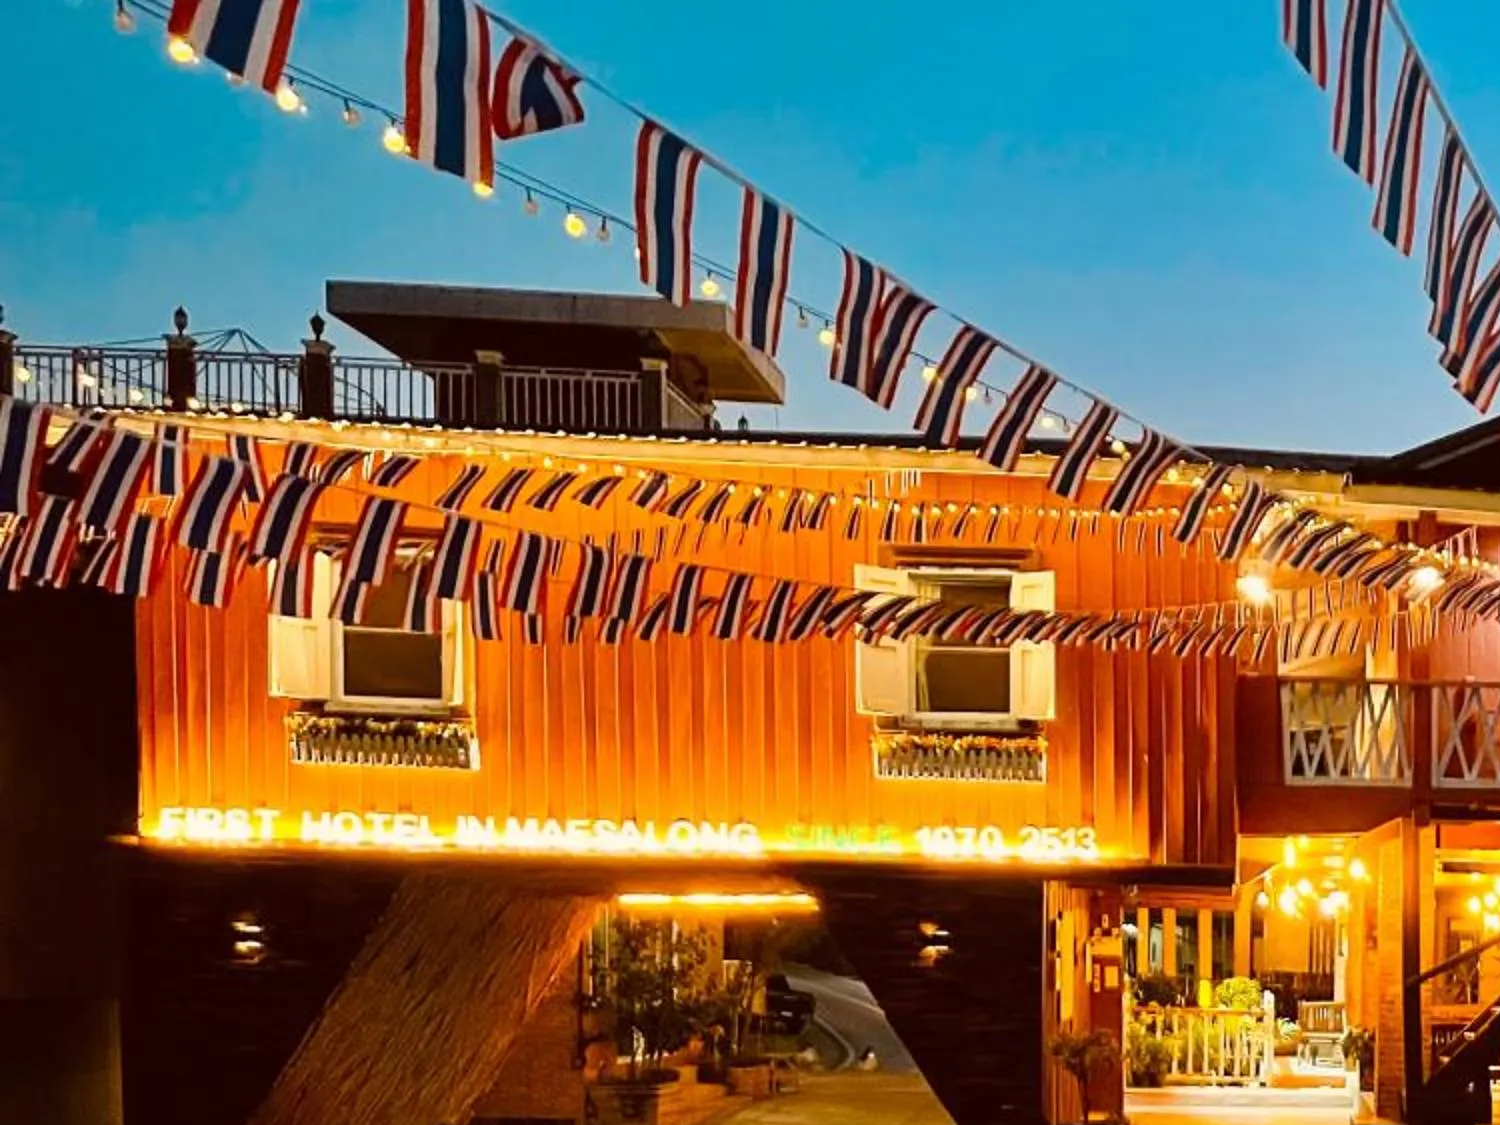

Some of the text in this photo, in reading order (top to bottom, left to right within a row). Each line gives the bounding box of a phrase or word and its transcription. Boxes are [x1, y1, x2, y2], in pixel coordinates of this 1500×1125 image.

[158, 807, 280, 842] FIRST
[301, 810, 442, 847] HOTEL
[456, 814, 497, 849] IN
[1019, 825, 1099, 861] 2513
